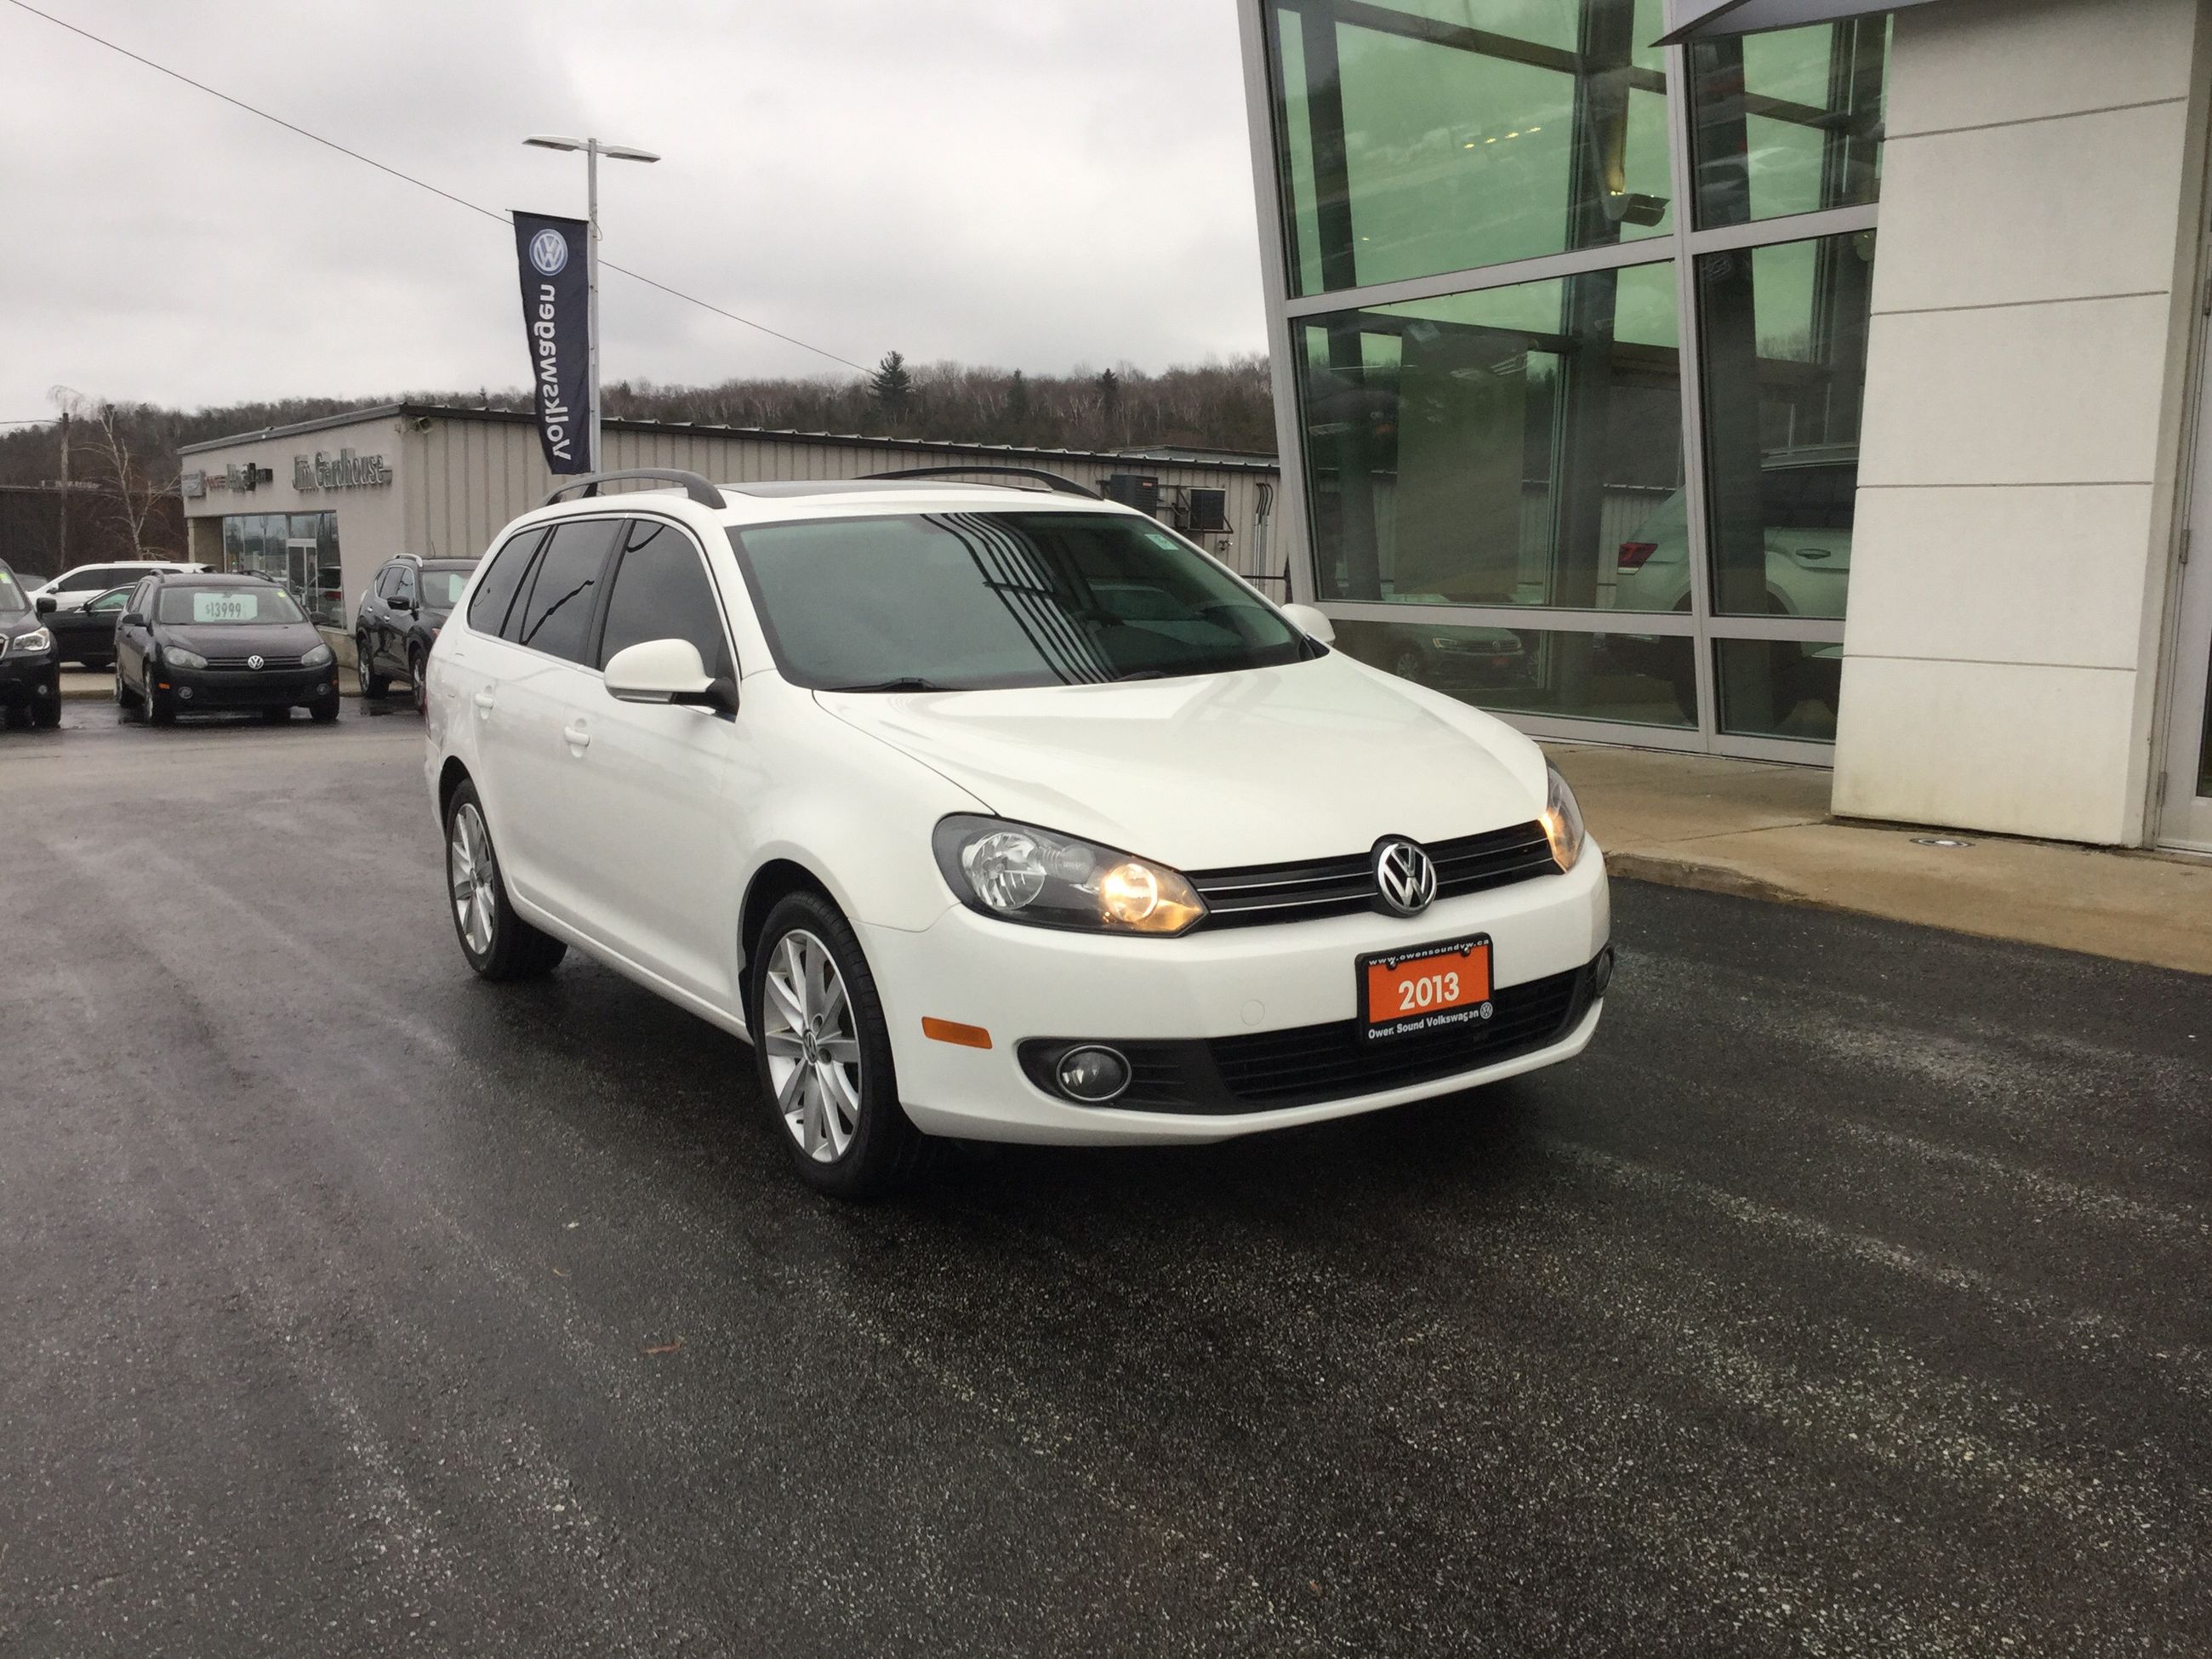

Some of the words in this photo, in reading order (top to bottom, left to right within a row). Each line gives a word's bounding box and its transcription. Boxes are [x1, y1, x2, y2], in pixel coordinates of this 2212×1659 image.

[1378, 842, 1437, 914] VW
[1398, 972, 1460, 1011] 2013
[1396, 1018, 1424, 1034] Sound
[1426, 1009, 1479, 1027] Volkswagen
